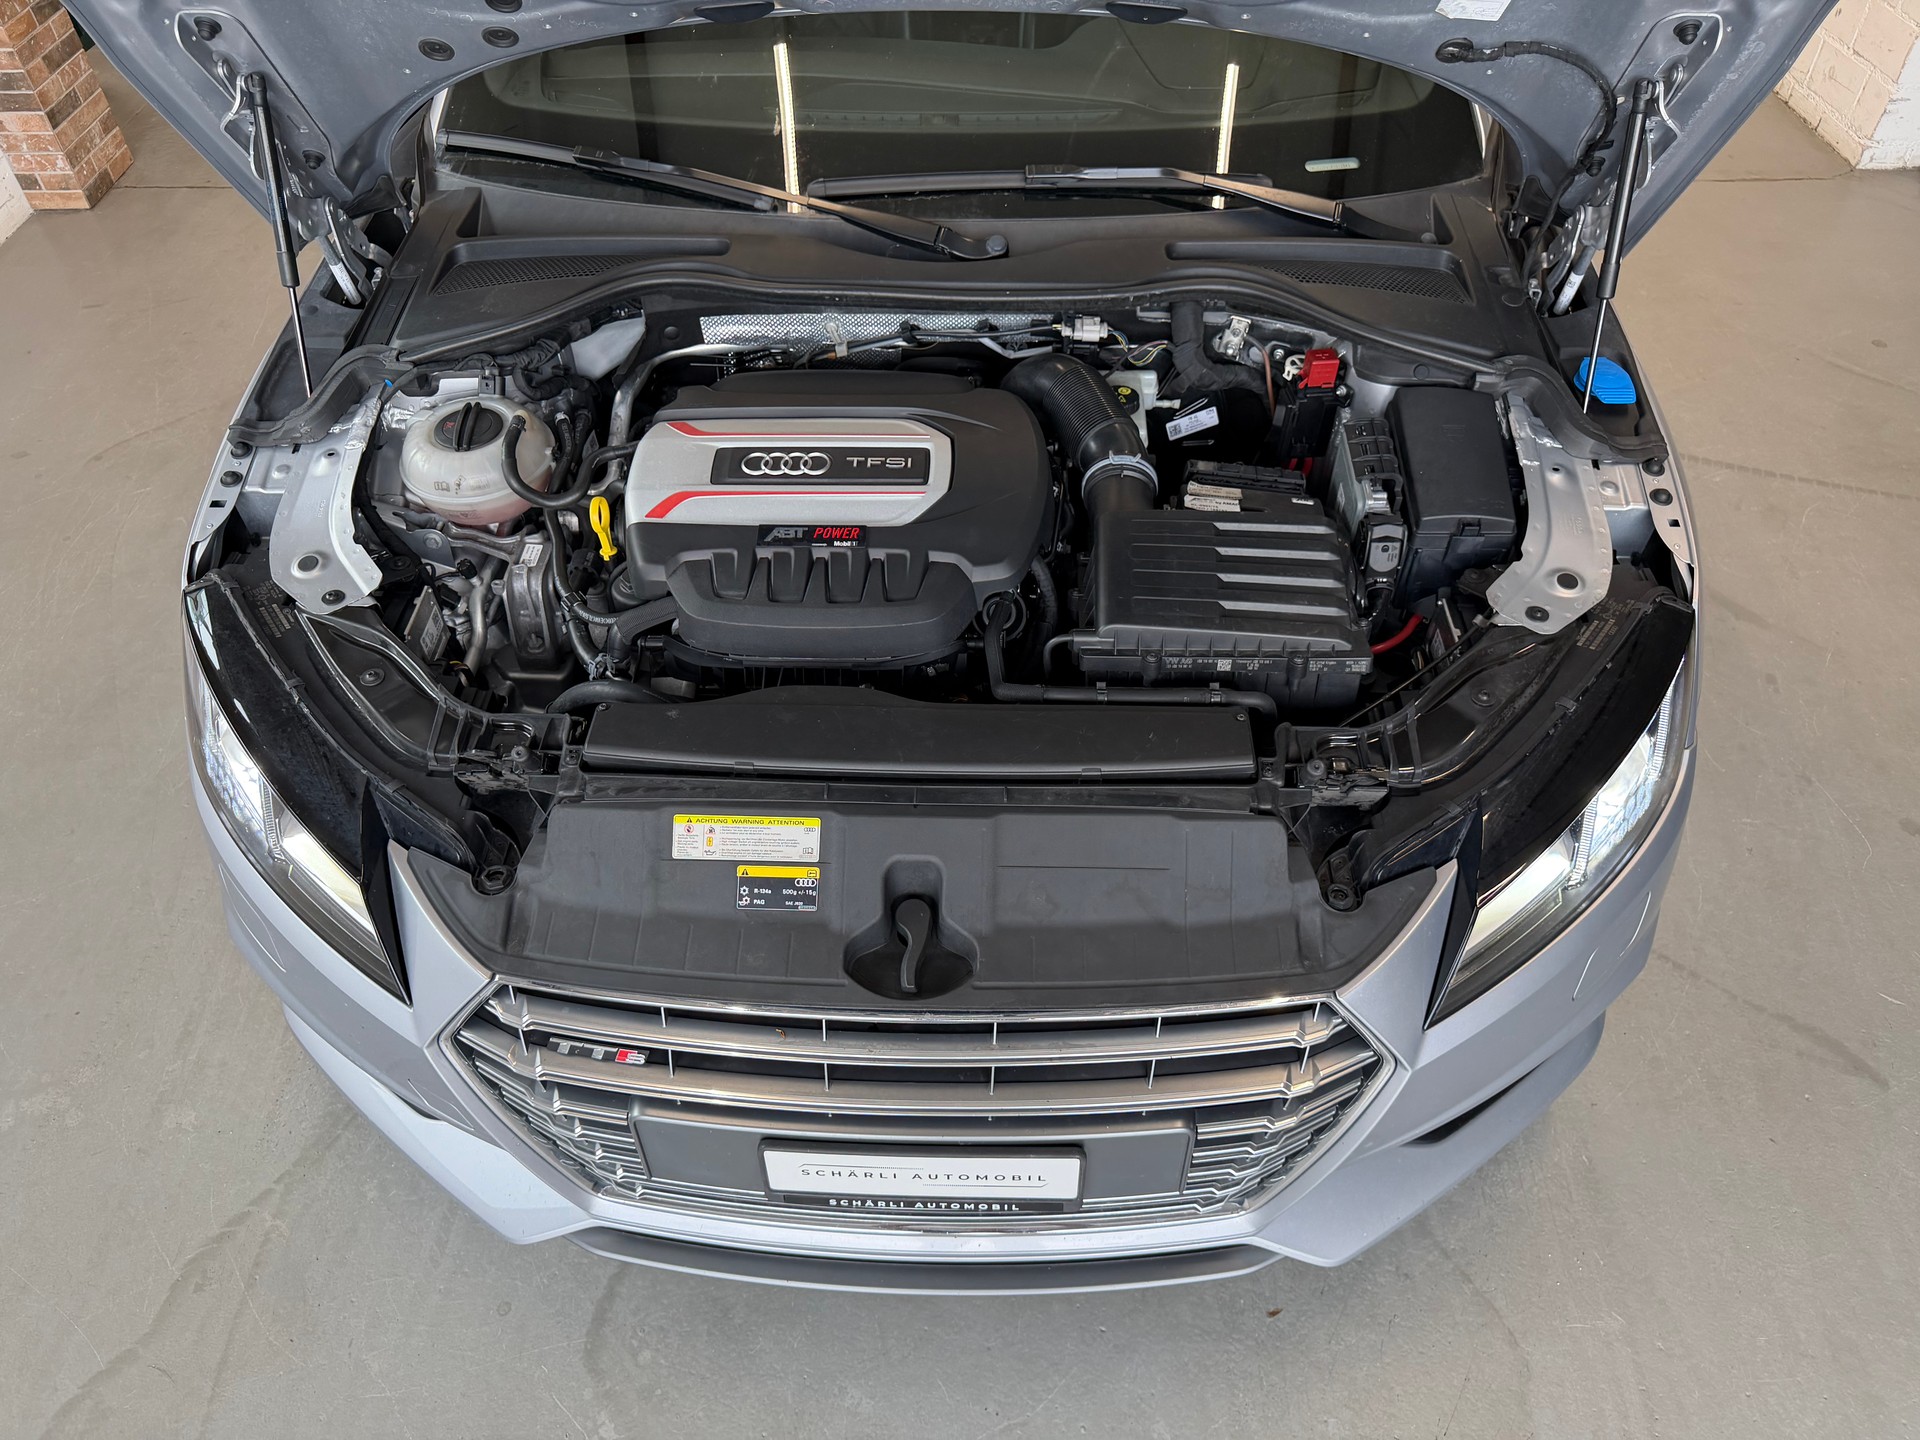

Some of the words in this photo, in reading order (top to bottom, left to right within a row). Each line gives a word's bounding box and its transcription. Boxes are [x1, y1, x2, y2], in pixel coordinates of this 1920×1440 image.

[846, 457, 912, 468] TFSI
[764, 527, 808, 542] ABT
[813, 527, 860, 539] POWER
[549, 1037, 646, 1065] TTS
[801, 1168, 899, 1180] SCHÄRLI
[911, 1173, 1047, 1182] AUTOMOBIL
[828, 1198, 905, 1209] SCHÄRLI
[914, 1201, 1020, 1212] AUTOMOBIL
